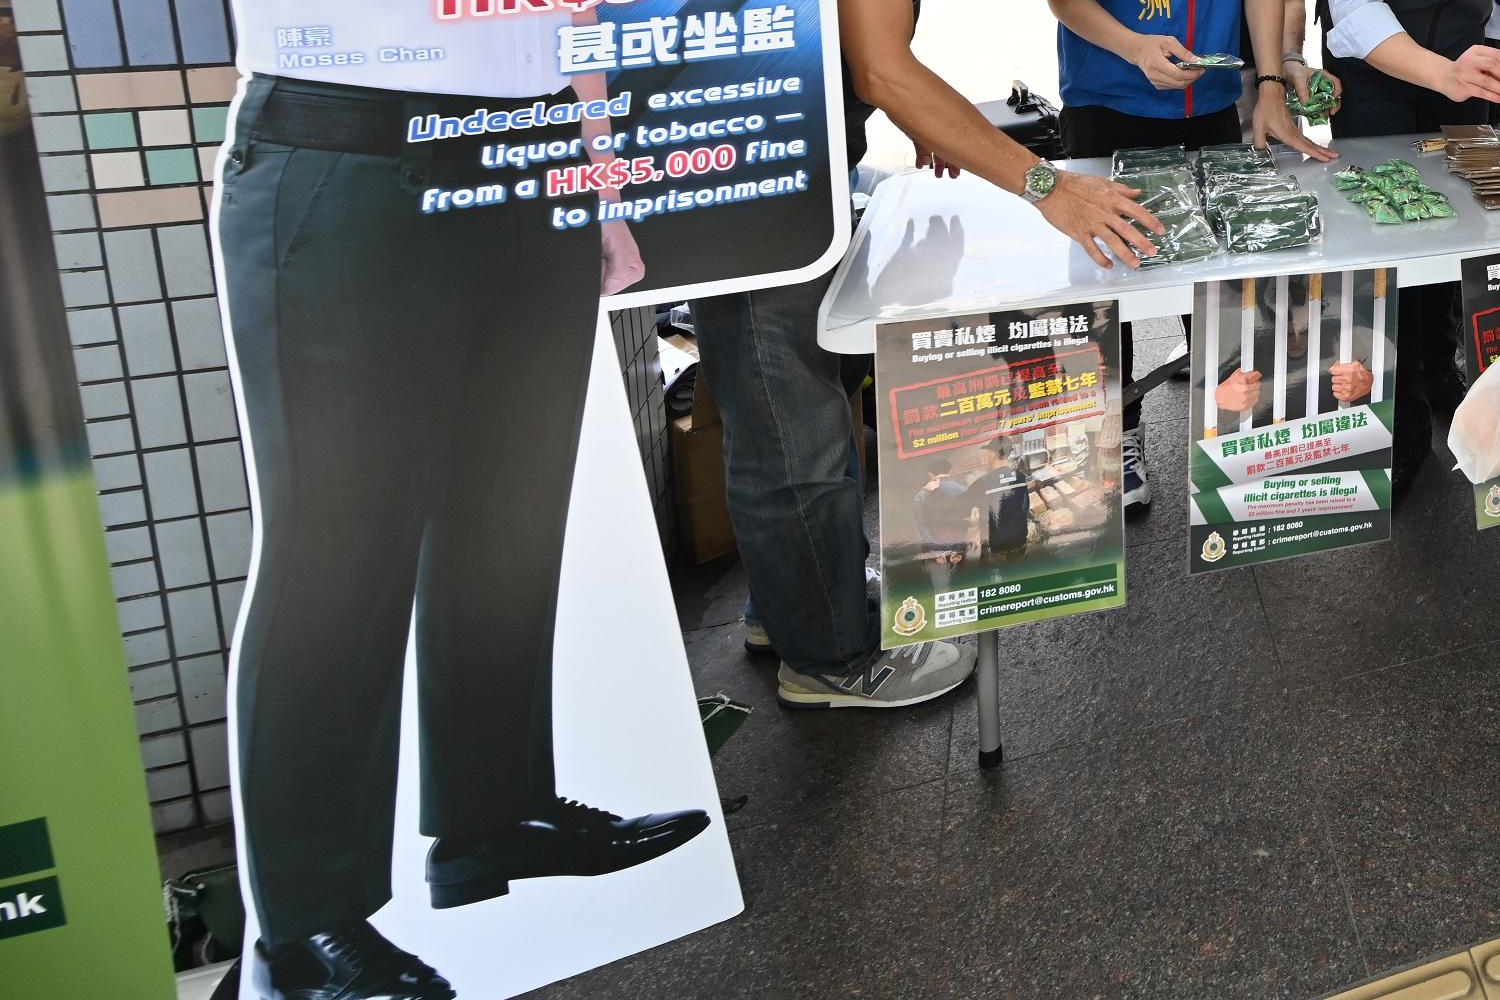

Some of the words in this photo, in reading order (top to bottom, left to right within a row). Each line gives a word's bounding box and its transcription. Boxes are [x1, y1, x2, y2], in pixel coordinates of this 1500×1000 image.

[558, 6, 795, 73] 甚或坐監
[278, 51, 364, 69] Moses
[379, 46, 444, 63] Chan
[407, 93, 630, 142] Undeclared
[648, 76, 801, 110] excessive
[481, 137, 583, 168] liquor
[592, 131, 628, 153] or
[637, 114, 765, 146] tobacco
[515, 178, 537, 198] a
[546, 144, 736, 197] HK$5,000
[552, 206, 588, 228] to
[599, 171, 807, 222] imprisonment
[912, 324, 996, 350] 買賣私煙
[1009, 315, 1088, 339] 均屬違法
[912, 352, 943, 363] Buying
[945, 351, 954, 359] or
[957, 347, 985, 358] selling
[987, 344, 1009, 354] illicit
[1010, 340, 1052, 352] cigarettes
[1054, 339, 1062, 347] is
[1064, 336, 1088, 346] illegal
[913, 438, 925, 448] $2
[927, 431, 959, 445] million
[1008, 415, 1035, 429] years'
[1037, 400, 1097, 420] imprisonment
[1222, 428, 1291, 457] 買賣私煙
[1302, 412, 1368, 439] 均屬違法
[1244, 491, 1267, 502] illicit
[1271, 489, 1316, 501] cigarettes
[1320, 488, 1327, 496] is
[1330, 486, 1357, 497] illegal
[1264, 478, 1295, 489] Buying
[1311, 476, 1341, 485] selling
[1272, 522, 1373, 544] crimereport@customs.gov.hk
[980, 587, 997, 598] 182
[999, 584, 1021, 595] 8080
[980, 585, 1115, 615] crimereport@customs.gov.hk
